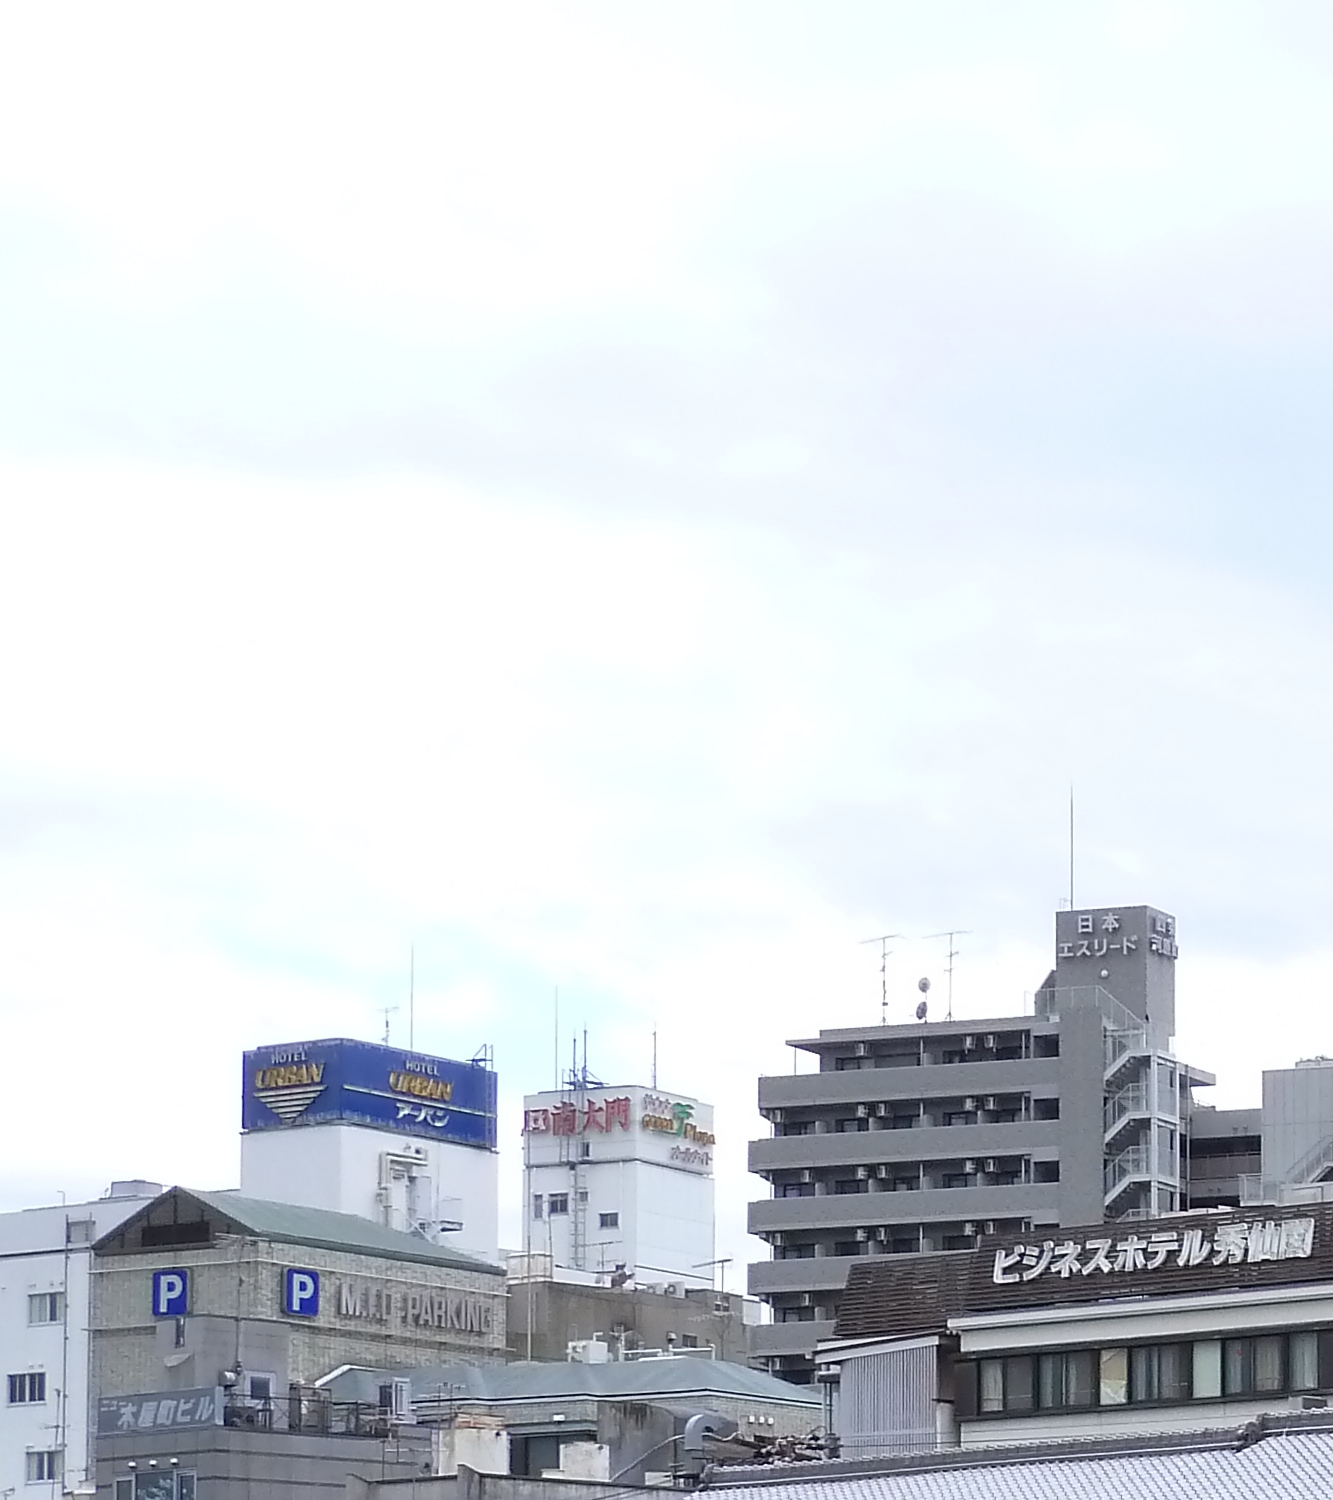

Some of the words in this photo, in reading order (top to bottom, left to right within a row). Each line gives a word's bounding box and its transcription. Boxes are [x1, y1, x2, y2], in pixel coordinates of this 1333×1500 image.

[1077, 912, 1120, 934] 日本
[1058, 934, 1139, 957] エスリード
[271, 1050, 308, 1064] HOTEL
[405, 1060, 440, 1077] HOTEL
[254, 1062, 325, 1089] URBAN
[388, 1071, 454, 1101] URBAN
[395, 1102, 450, 1128] アーバン
[551, 1096, 632, 1136] 南大門
[293, 1273, 316, 1311] P
[406, 1292, 492, 1333] PARKING
